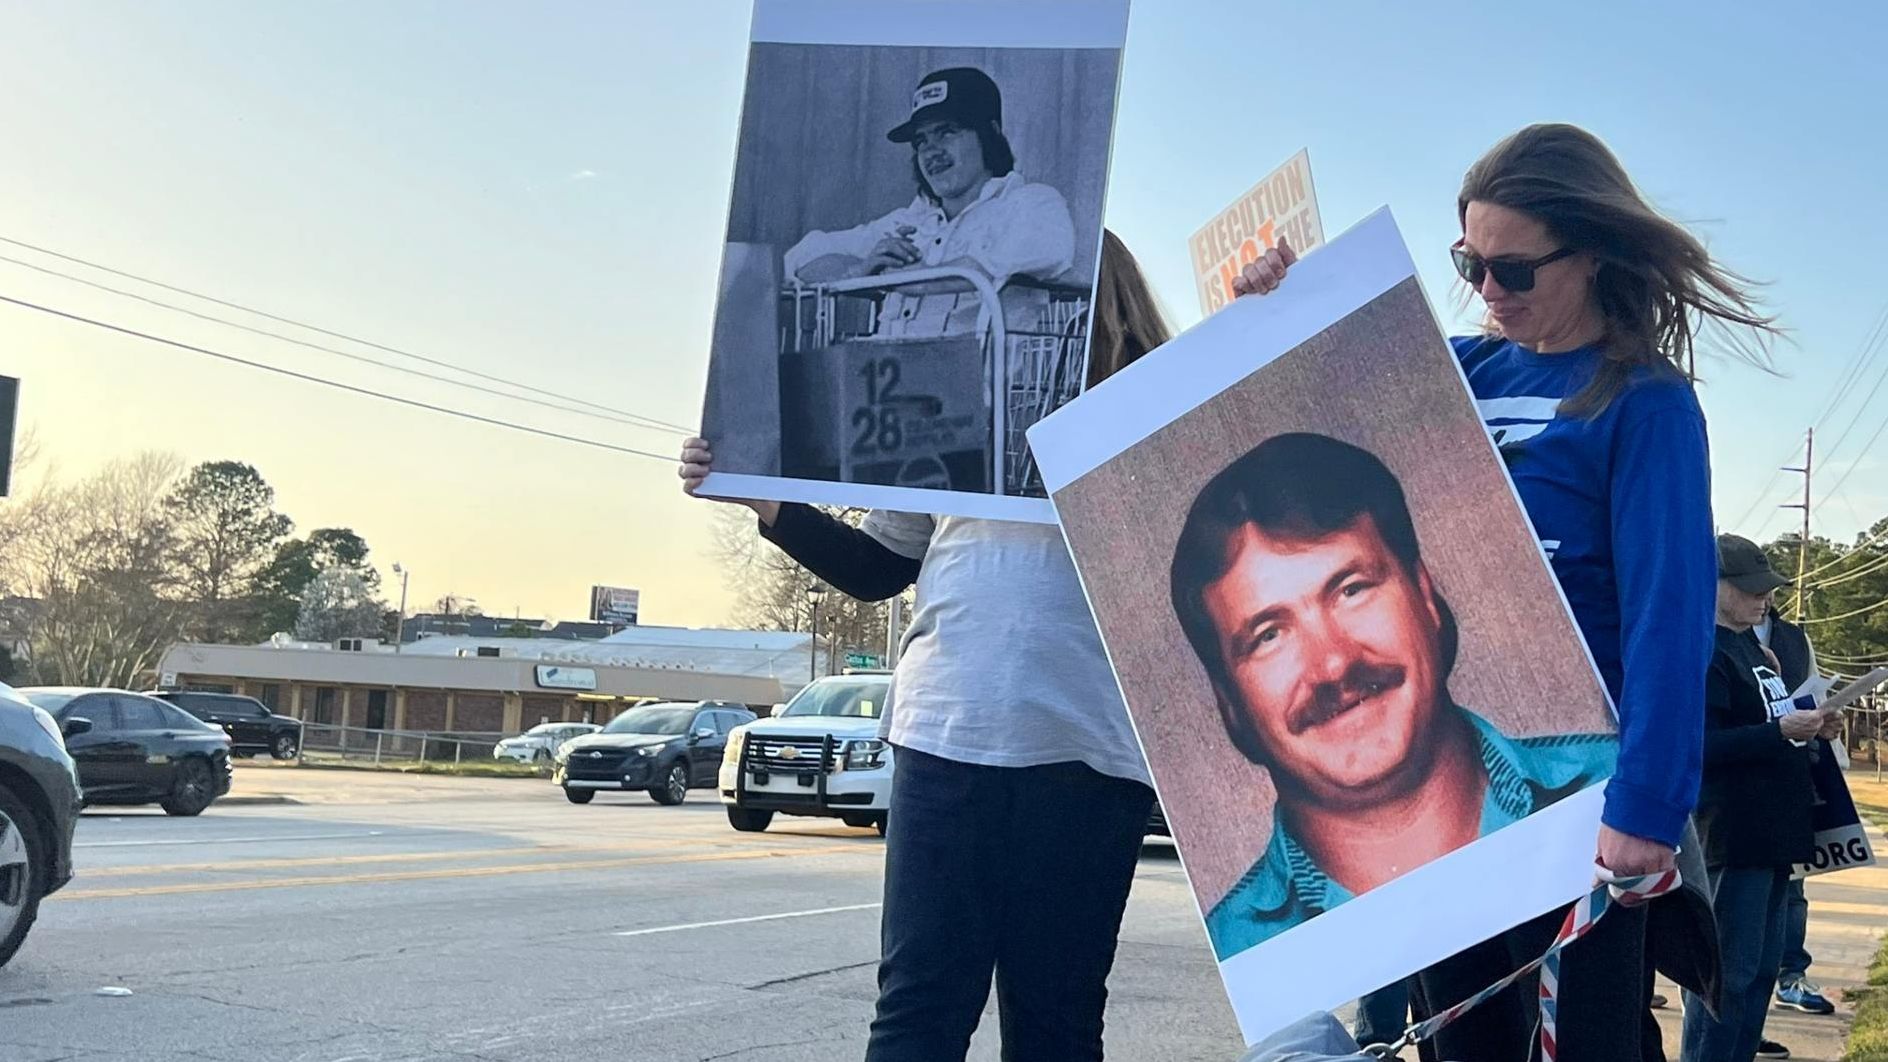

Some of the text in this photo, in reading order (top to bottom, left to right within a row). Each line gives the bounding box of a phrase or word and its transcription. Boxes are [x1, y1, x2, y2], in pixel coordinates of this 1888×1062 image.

[1196, 160, 1305, 274] EXECUTION
[1204, 275, 1225, 314] IS
[859, 356, 901, 404] 12
[852, 406, 902, 454] 28
[1788, 838, 1868, 875] .ORG
